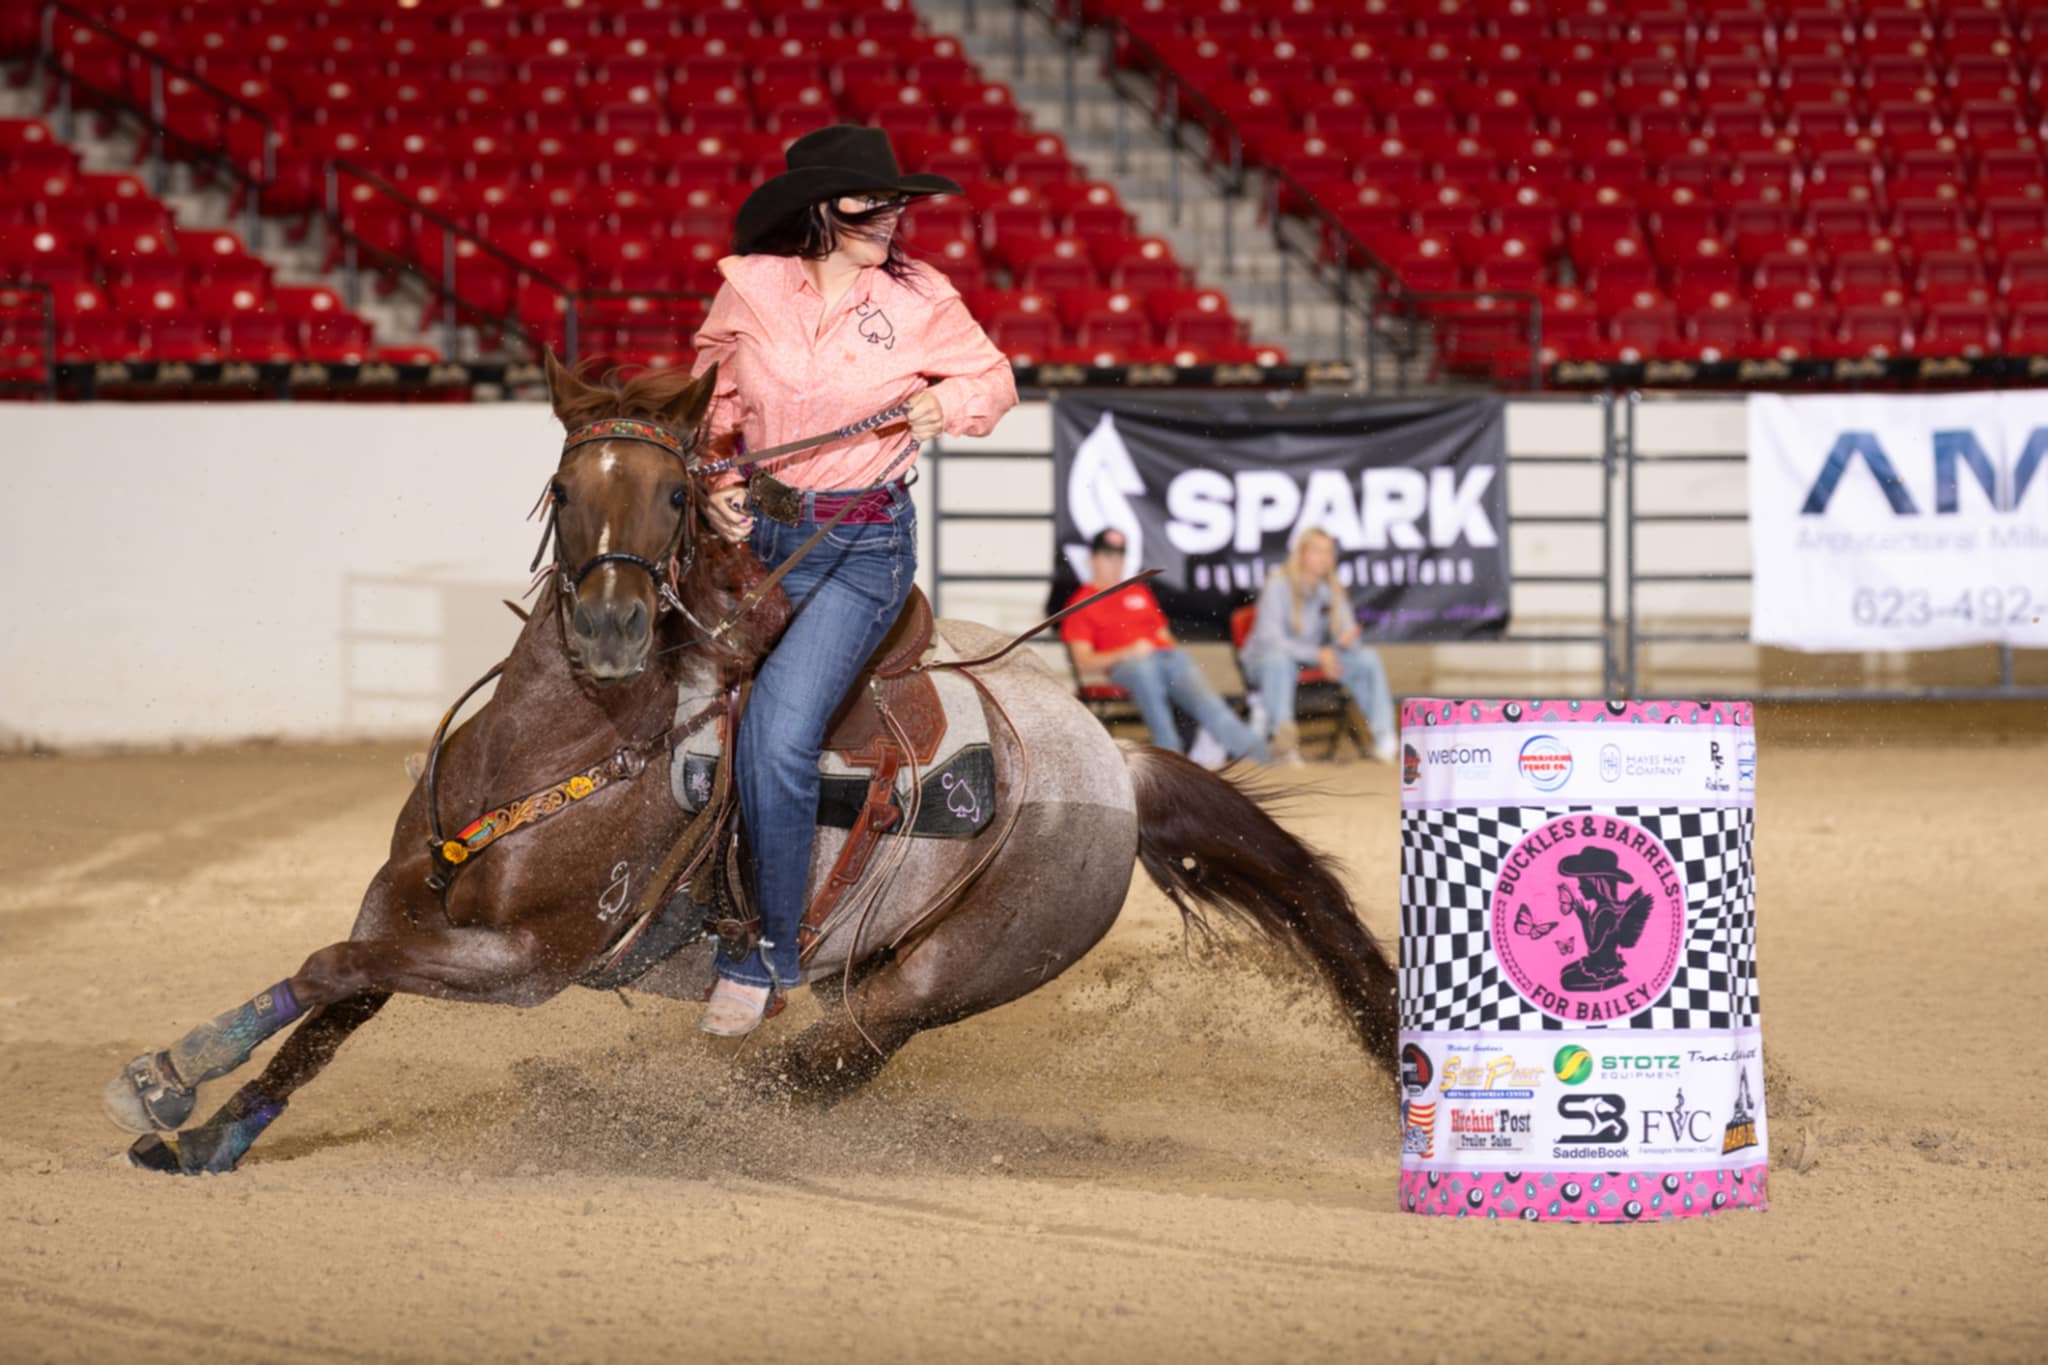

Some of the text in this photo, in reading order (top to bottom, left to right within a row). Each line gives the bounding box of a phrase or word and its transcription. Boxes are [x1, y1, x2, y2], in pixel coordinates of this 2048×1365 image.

[1165, 465, 1498, 555] SPARK
[1427, 747, 1492, 765] wecom
[1498, 815, 1680, 897] BUCKLES & BARRELS
[1530, 983, 1651, 1021] FOR BAILEY
[1601, 1055, 1681, 1070] STOTZ
[1600, 1072, 1680, 1080] EQUIPMENT
[1499, 1109, 1531, 1133] Post
[1640, 1110, 1712, 1144] FVC
[1552, 1146, 1629, 1159] SaddleBook
